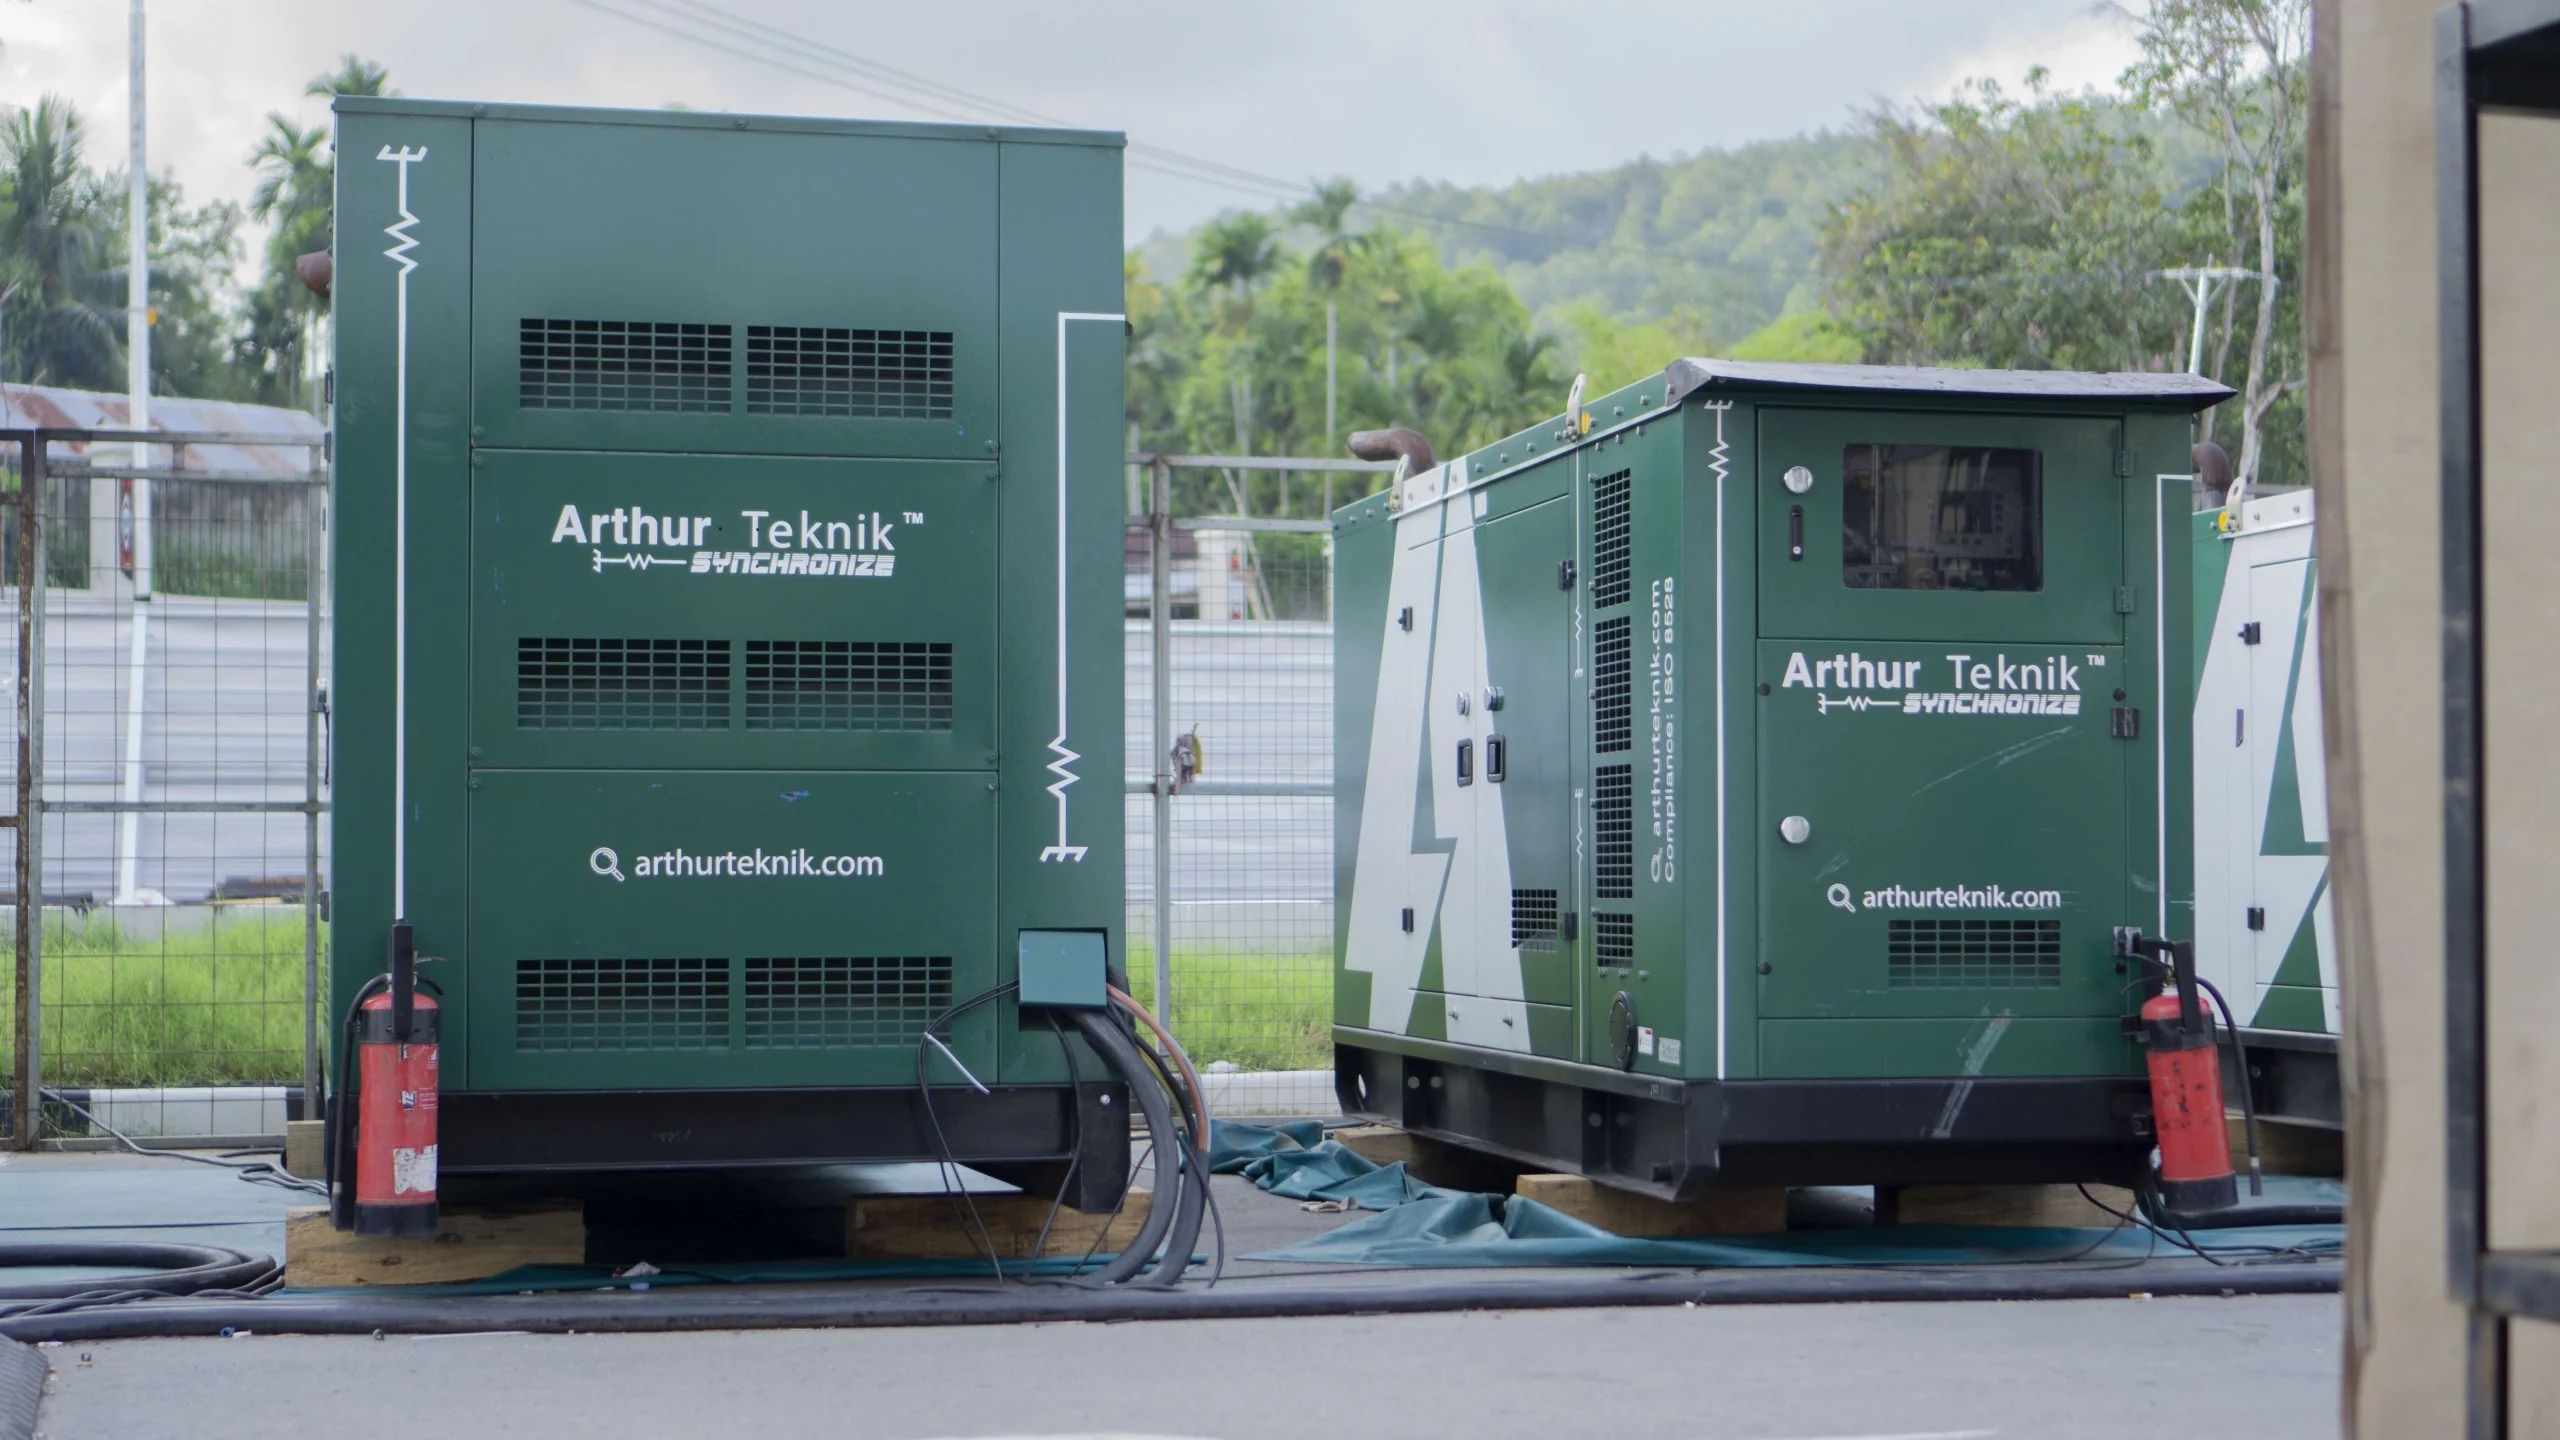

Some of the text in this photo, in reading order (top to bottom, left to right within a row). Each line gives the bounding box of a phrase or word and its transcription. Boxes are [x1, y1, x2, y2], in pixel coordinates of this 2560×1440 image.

[551, 504, 711, 547] Arthur
[742, 510, 895, 551] Teknik
[690, 551, 896, 577] SYNCHRONIZE
[1781, 651, 1921, 689] Arthur
[1945, 653, 2081, 691] Teknik
[1649, 579, 1662, 837] arthurteknik.com
[1902, 692, 2081, 715] SYNCHRONIZE
[1663, 576, 1677, 883] Compliance: ISO 8528
[634, 847, 884, 876] arthurteknik.com
[1862, 884, 2061, 908] arthurteknik.com
